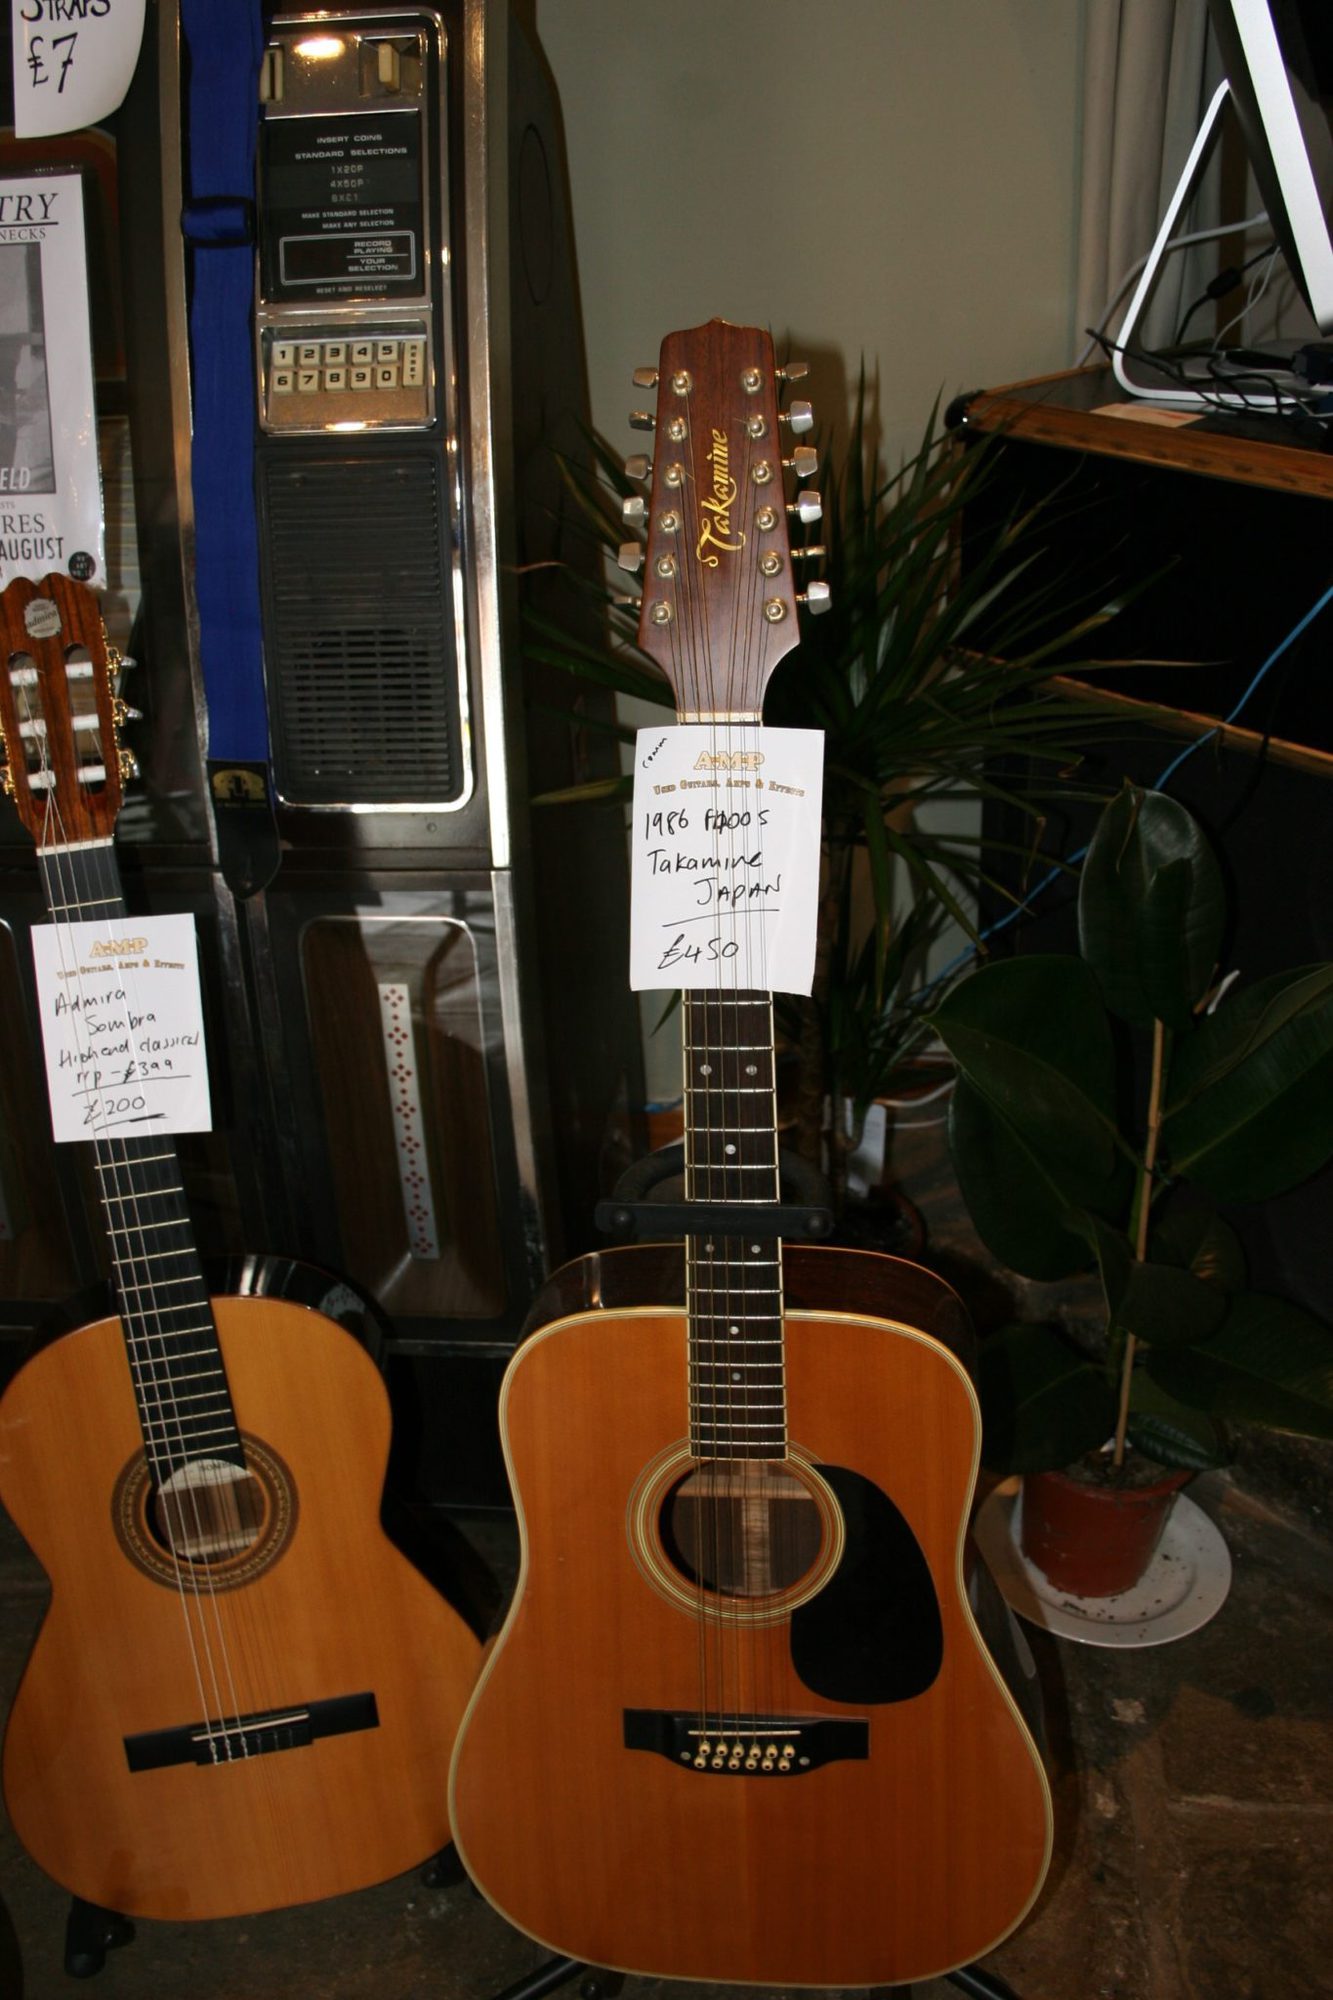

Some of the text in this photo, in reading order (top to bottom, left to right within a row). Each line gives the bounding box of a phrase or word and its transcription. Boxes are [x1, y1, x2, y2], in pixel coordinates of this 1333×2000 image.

[27, 32, 78, 93] £7
[316, 134, 383, 144] INSERT COINS
[295, 147, 408, 160] STANDARD SELECTIONS
[301, 208, 394, 219] MAKE STANDARD SELECTION
[322, 220, 395, 230] MAKE ANY SELECTION
[353, 240, 392, 248] RECORD
[353, 247, 393, 255] PLAYING
[348, 264, 398, 272] SELECTION
[316, 286, 336, 294] RESET
[304, 349, 315, 358] 2
[329, 347, 340, 357] 3
[357, 347, 368, 356] 4
[382, 345, 392, 355] 5
[277, 370, 391, 386] 6 7 8 9 0
[696, 428, 746, 568] Takamine
[645, 808, 689, 840] 1986
[647, 849, 763, 875] Takamine
[657, 934, 739, 970] £450
[55, 988, 126, 1017] Admira
[85, 1011, 156, 1035] Sombra
[83, 1096, 145, 1125] £200
